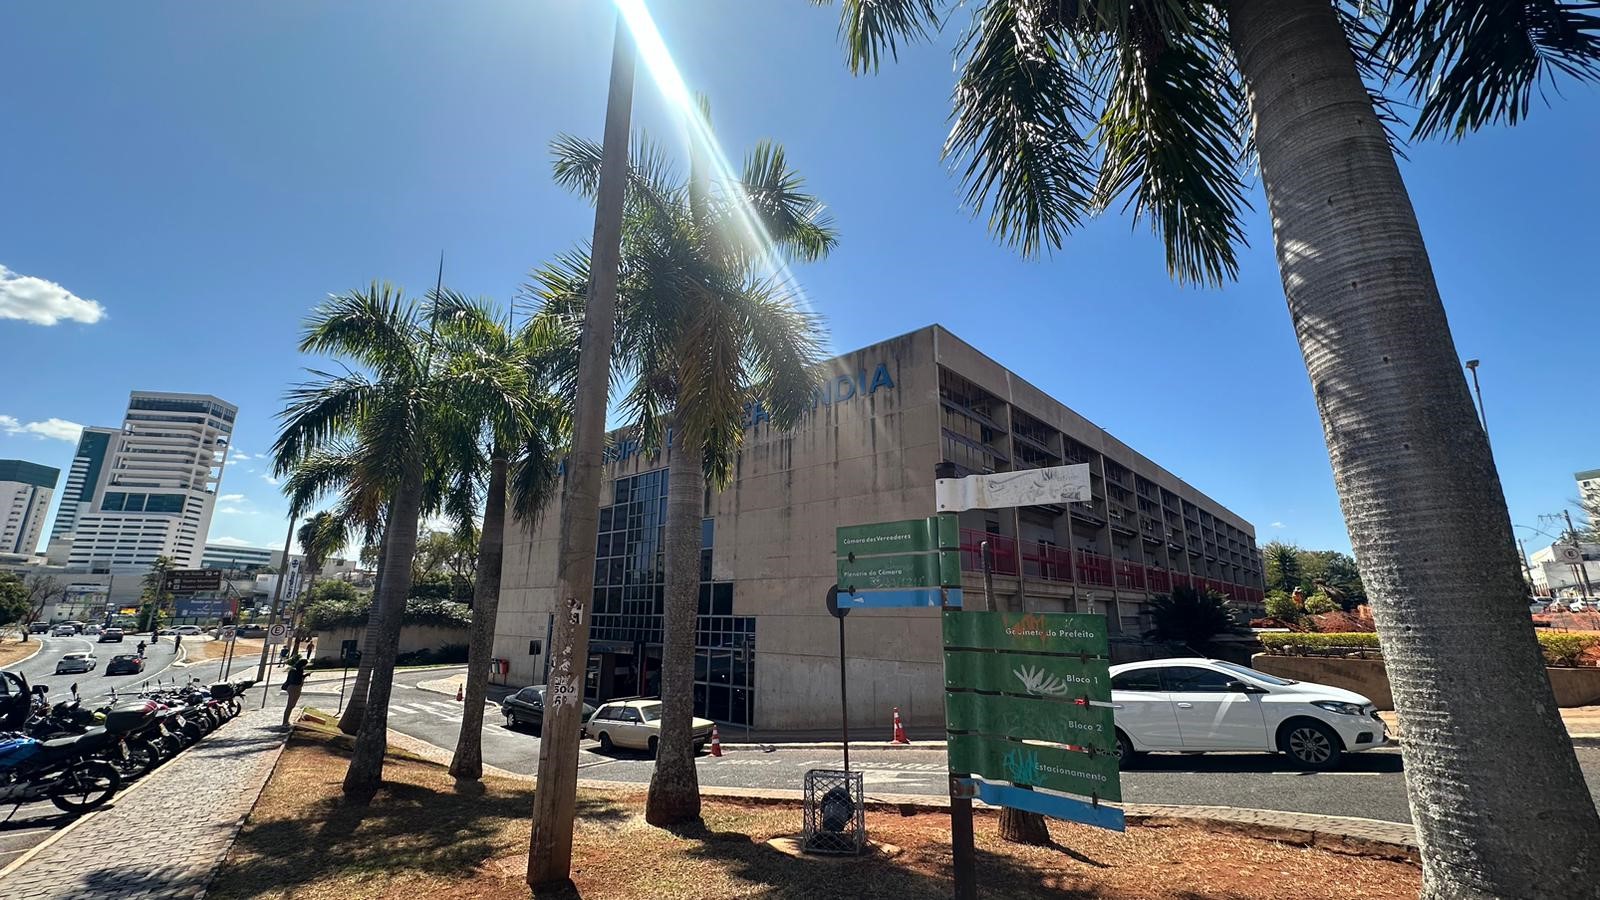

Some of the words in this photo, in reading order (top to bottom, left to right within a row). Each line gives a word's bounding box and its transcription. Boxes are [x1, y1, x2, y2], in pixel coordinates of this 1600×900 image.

[876, 533, 911, 542] Vereadores
[1059, 629, 1094, 639] Prefeito
[1066, 674, 1091, 684] Bloco
[1094, 677, 1098, 685] 1
[1068, 720, 1093, 732] Bloco
[1096, 724, 1103, 732] 2
[1035, 762, 1107, 782] Estacionamento
